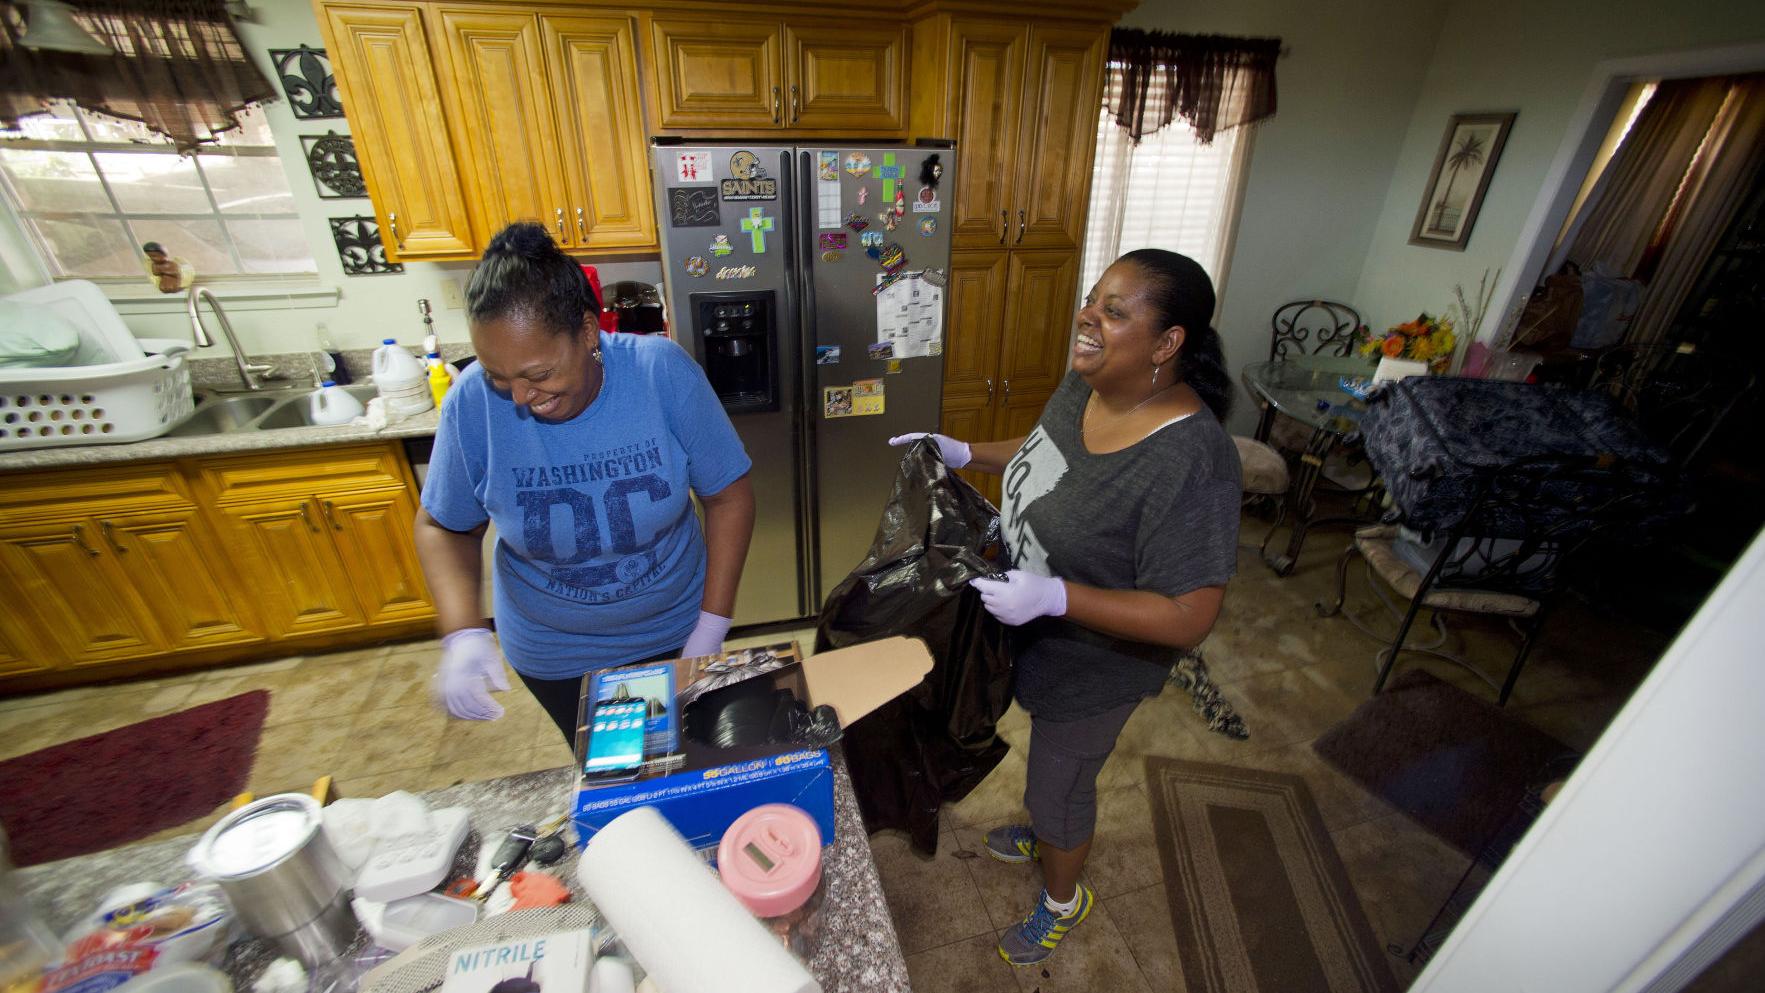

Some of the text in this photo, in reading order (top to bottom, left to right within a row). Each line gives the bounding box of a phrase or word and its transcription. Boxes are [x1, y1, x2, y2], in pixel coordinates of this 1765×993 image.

[723, 180, 776, 196] SAINTS
[584, 437, 657, 462] PROPERTY OF
[511, 446, 663, 488] WASHINGTON
[516, 472, 673, 566] DC
[615, 563, 666, 596] CAPITAL
[719, 760, 766, 777] GALLON
[790, 750, 823, 763] BAGS
[454, 940, 546, 975] NITRILE
